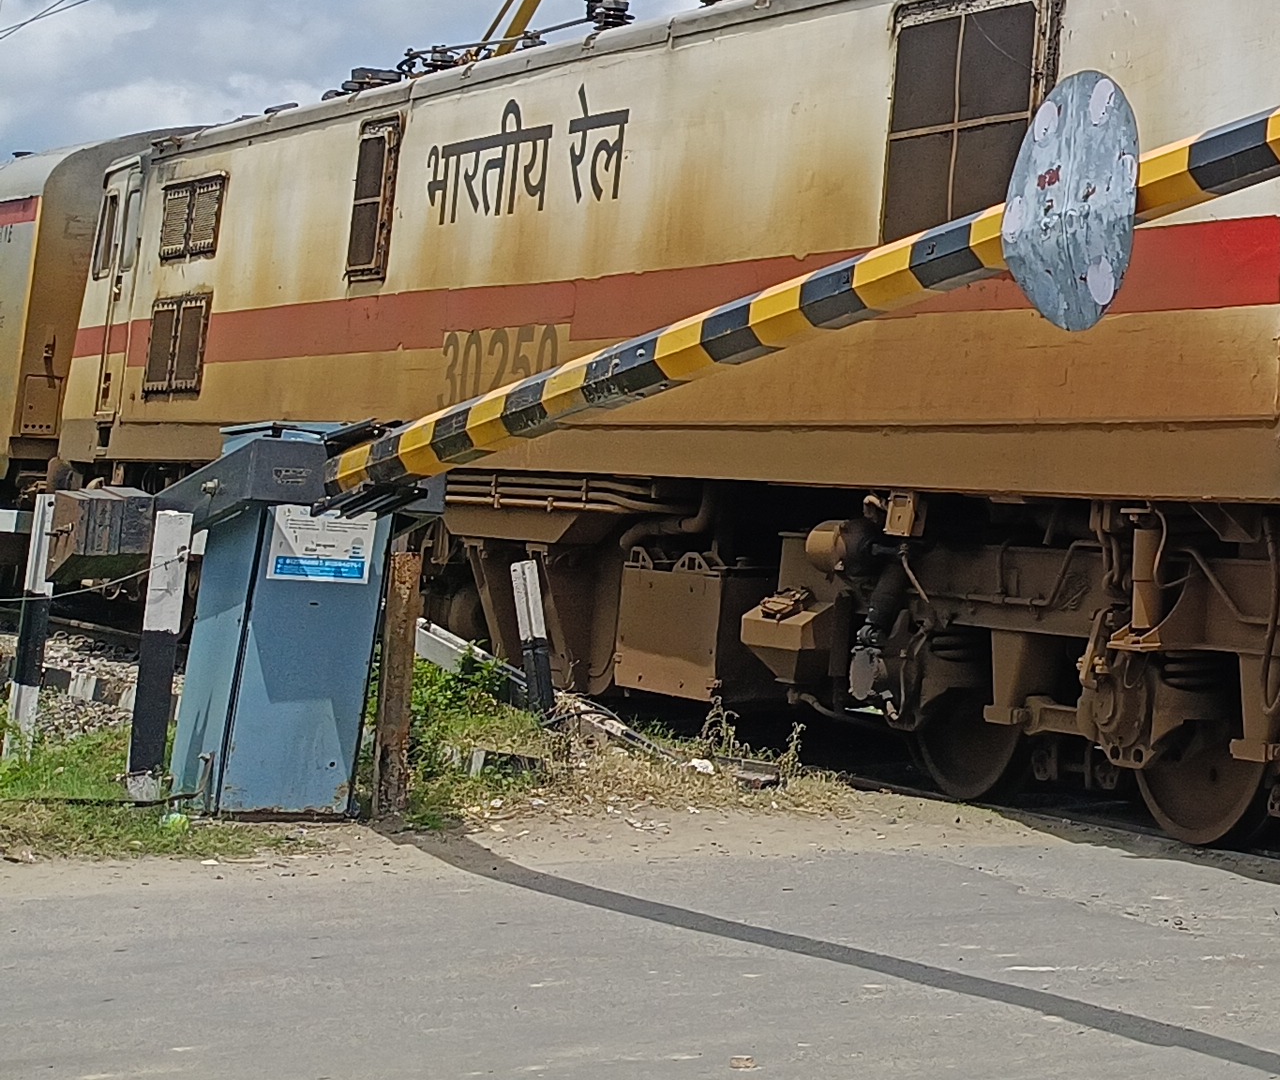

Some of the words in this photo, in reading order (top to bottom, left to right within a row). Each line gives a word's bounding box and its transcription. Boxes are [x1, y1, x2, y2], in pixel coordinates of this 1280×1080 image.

[427, 99, 553, 225] भारतीय
[568, 83, 630, 203] रेल
[437, 324, 558, 410] 30250
